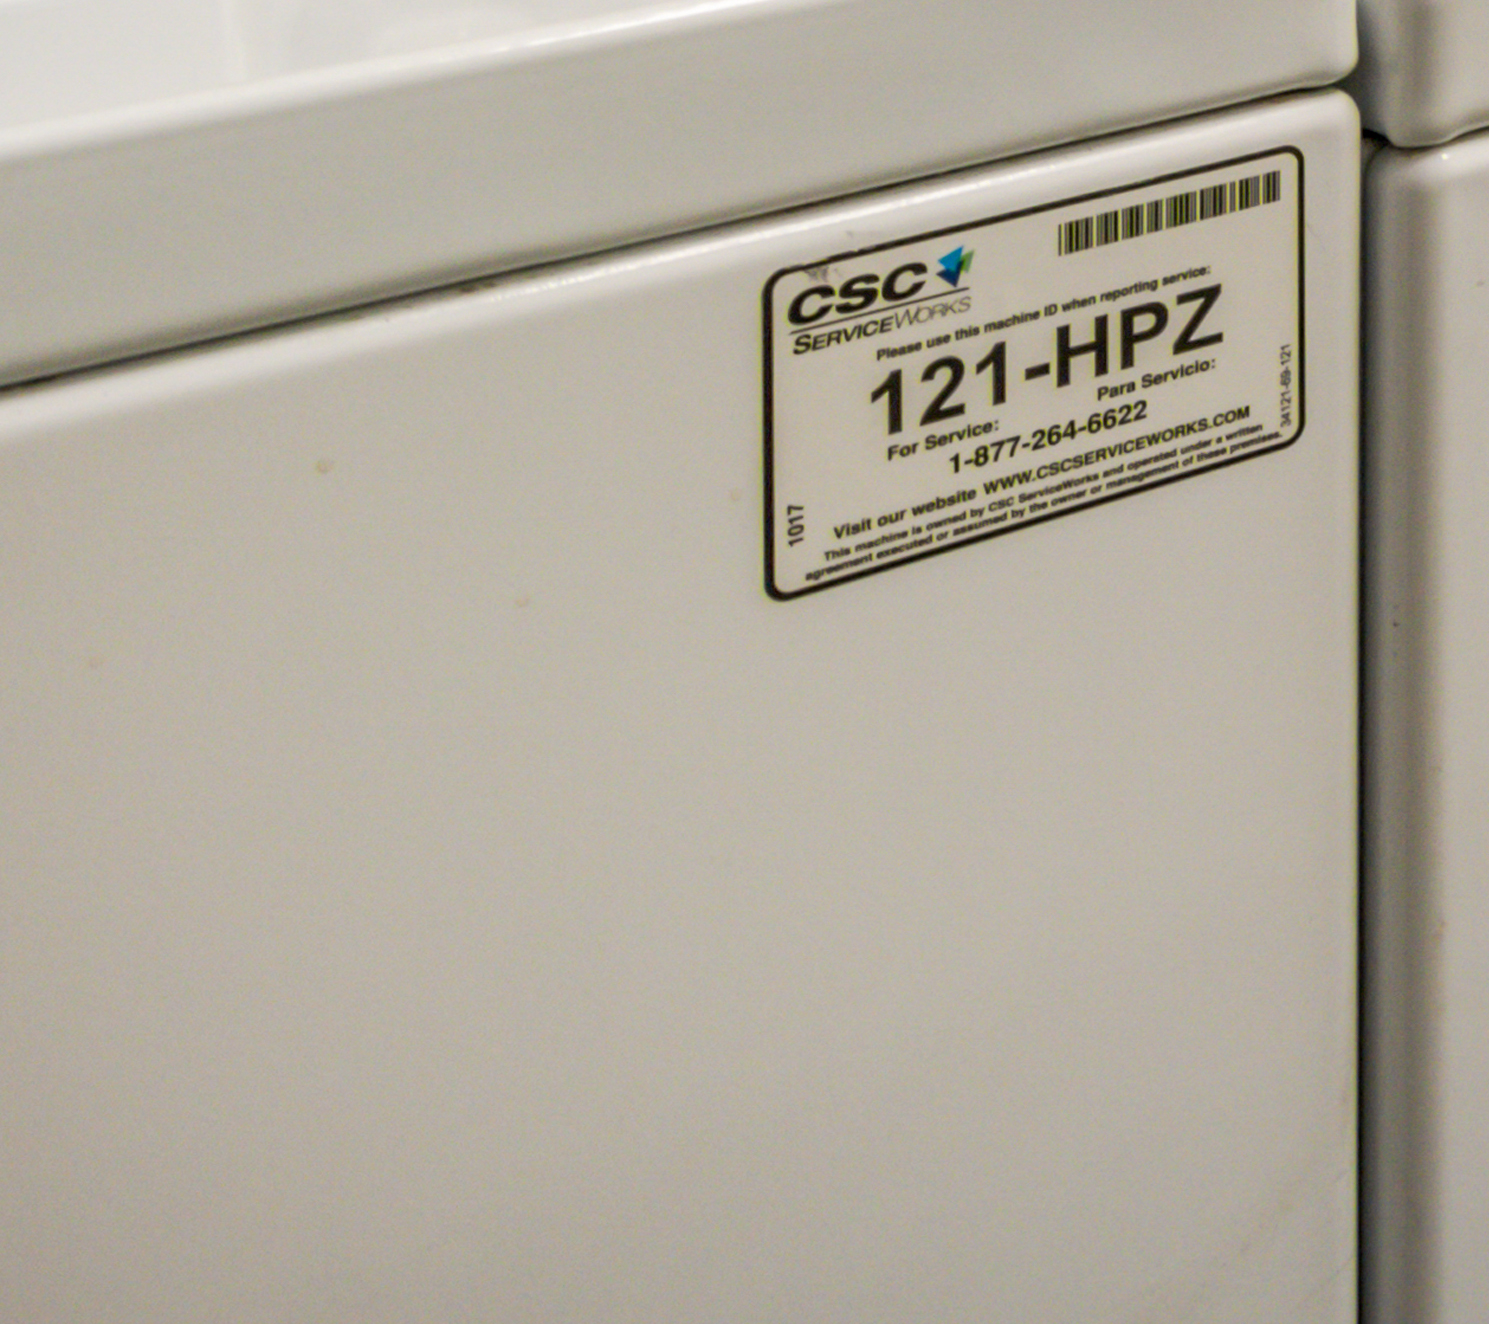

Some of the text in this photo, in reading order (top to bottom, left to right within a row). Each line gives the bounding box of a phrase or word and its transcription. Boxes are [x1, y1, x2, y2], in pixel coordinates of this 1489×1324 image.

[788, 262, 928, 326] CSC
[876, 266, 1211, 361] Please use this machine ID when reporting service:
[871, 283, 1223, 435] 121-HPZ
[1097, 358, 1215, 401] Para Servicio:
[834, 405, 1250, 539] Visit our website WWW.CSCSERVICEWORKS.COM
[888, 420, 999, 461] For Service:
[949, 399, 1148, 474] 1-877-264-6622
[787, 504, 804, 547] 1017
[805, 431, 1283, 581] agreement executed or assumed by the owner or management of these premises.
[824, 423, 1263, 562] This machine is owned by CSC ServiceWorks and operated under a written
